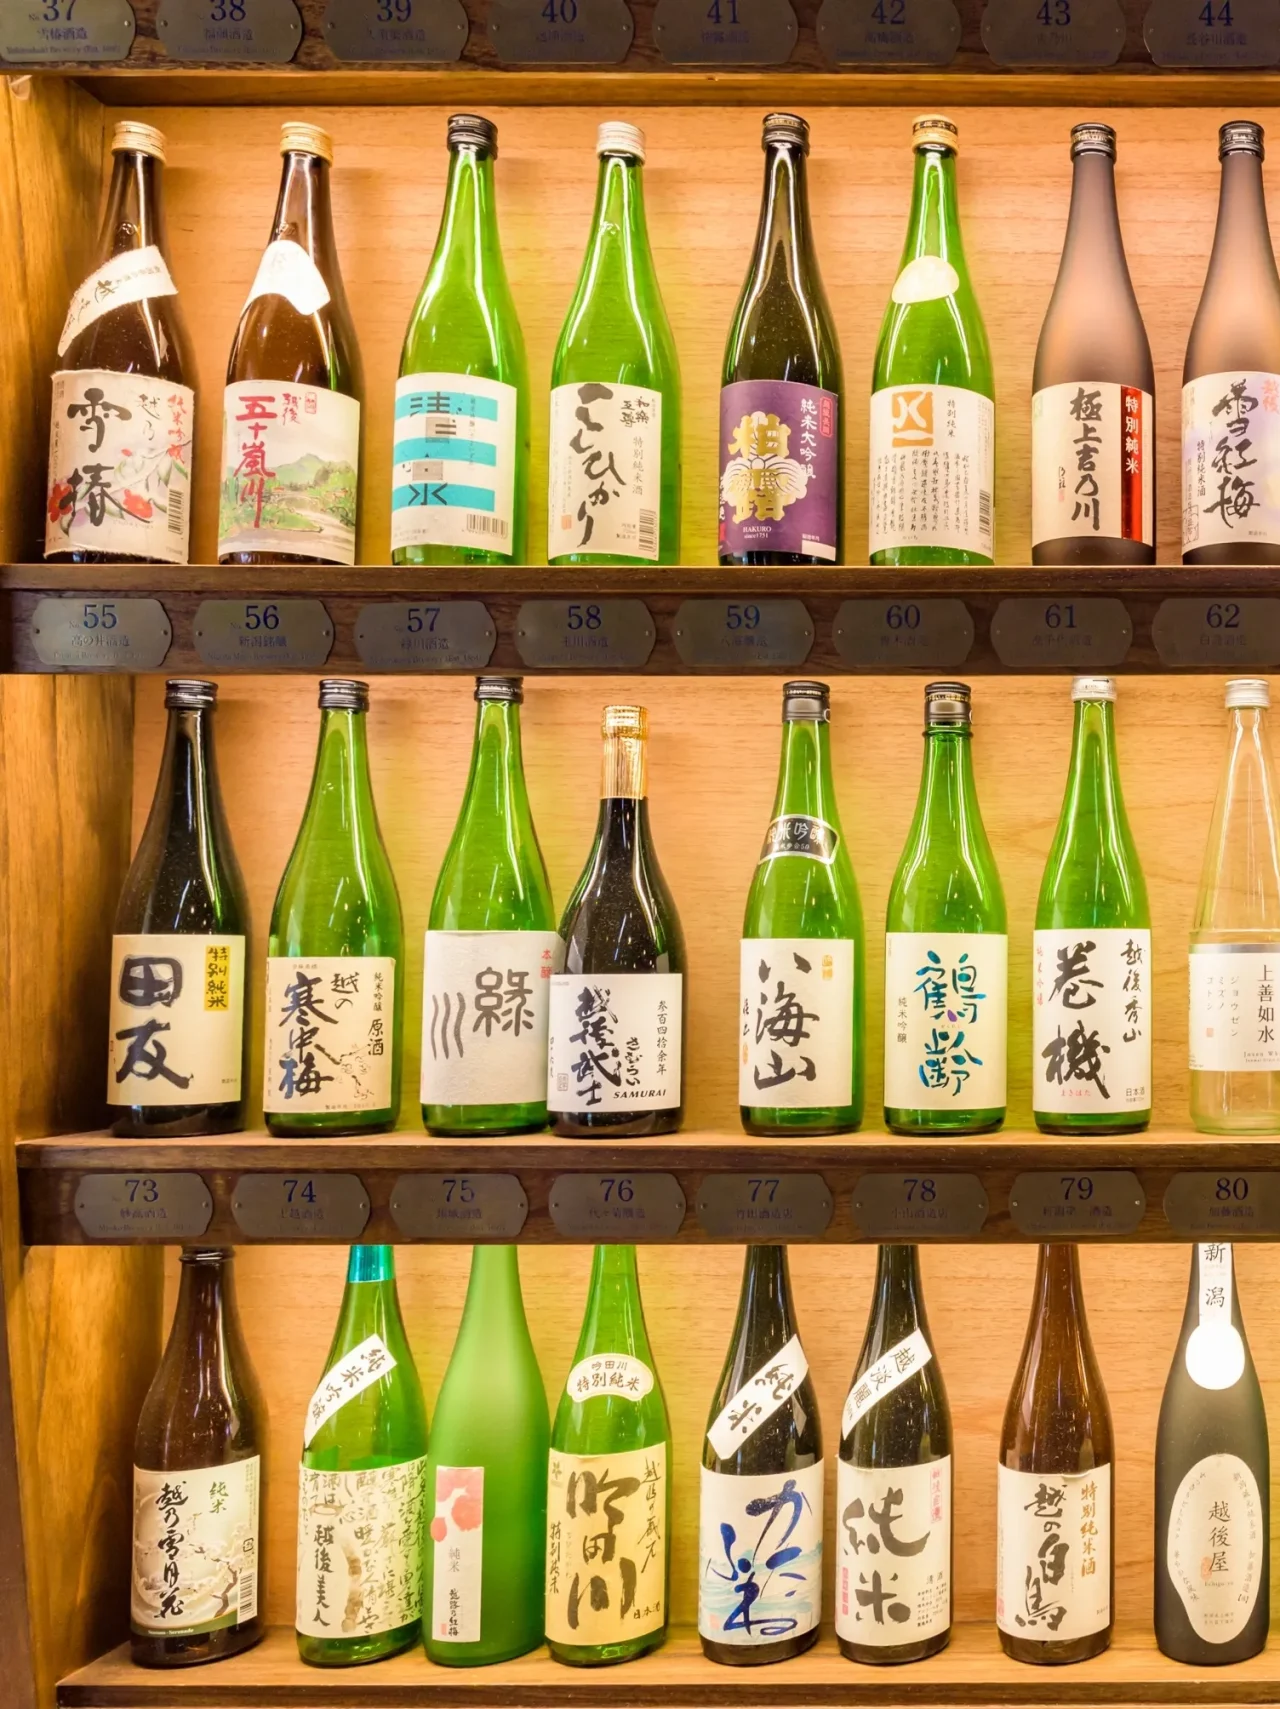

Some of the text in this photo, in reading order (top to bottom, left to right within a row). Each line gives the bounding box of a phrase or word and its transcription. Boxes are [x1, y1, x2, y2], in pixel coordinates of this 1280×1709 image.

[43, 0, 77, 21] 37
[210, 0, 247, 21] 38
[376, 0, 413, 22] 39
[540, 0, 578, 23] 40
[706, 0, 741, 24] 41
[870, 0, 906, 25] 42
[1036, 0, 1072, 25] 43
[1198, 0, 1235, 26] 44
[1125, 394, 1140, 476] 特別純米
[60, 387, 151, 527] 雪椿
[234, 395, 277, 529] 五十嵐川
[1069, 387, 1103, 532] 極上吉乃川
[1203, 378, 1261, 530] 雪紅梅
[742, 525, 772, 533] HAKURO
[82, 604, 118, 629] 55
[244, 605, 280, 630] 56
[406, 608, 441, 633] 57
[566, 605, 602, 630] 58
[726, 604, 762, 630] 59
[886, 604, 922, 630] 60
[1045, 604, 1078, 629] 61
[1205, 603, 1241, 629] 62
[206, 946, 229, 1010] 特別純米
[329, 971, 361, 1010] 越の
[366, 971, 384, 1057] 純米吟醸 原酒
[1256, 963, 1276, 1044] 上善如水
[115, 954, 195, 1091] 田友
[753, 951, 821, 1091] 八海山
[897, 996, 908, 1044] 純米吟醸
[1041, 940, 1112, 1101] 巻機
[278, 971, 340, 1100] 寒中梅
[570, 984, 622, 1106] 越後武士
[612, 1087, 667, 1101] SAMURAI
[124, 1179, 160, 1203] 73
[282, 1179, 317, 1204] 74
[441, 1179, 476, 1203] 75
[599, 1179, 634, 1202] 76
[747, 1179, 781, 1203] 77
[903, 1178, 937, 1202] 78
[1060, 1177, 1094, 1201] 79
[1215, 1177, 1249, 1201] 80
[1203, 1242, 1227, 1308] 新潟
[576, 1372, 640, 1394] 特別純米
[208, 1481, 230, 1515] 純米
[1080, 1480, 1099, 1579] 特別純米酒
[1208, 1500, 1233, 1574] 越後屋
[153, 1479, 190, 1620] 越乃雪月花
[448, 1547, 461, 1574] 純米
[842, 1486, 932, 1627] 純米
[312, 1523, 335, 1627] 越後美人
